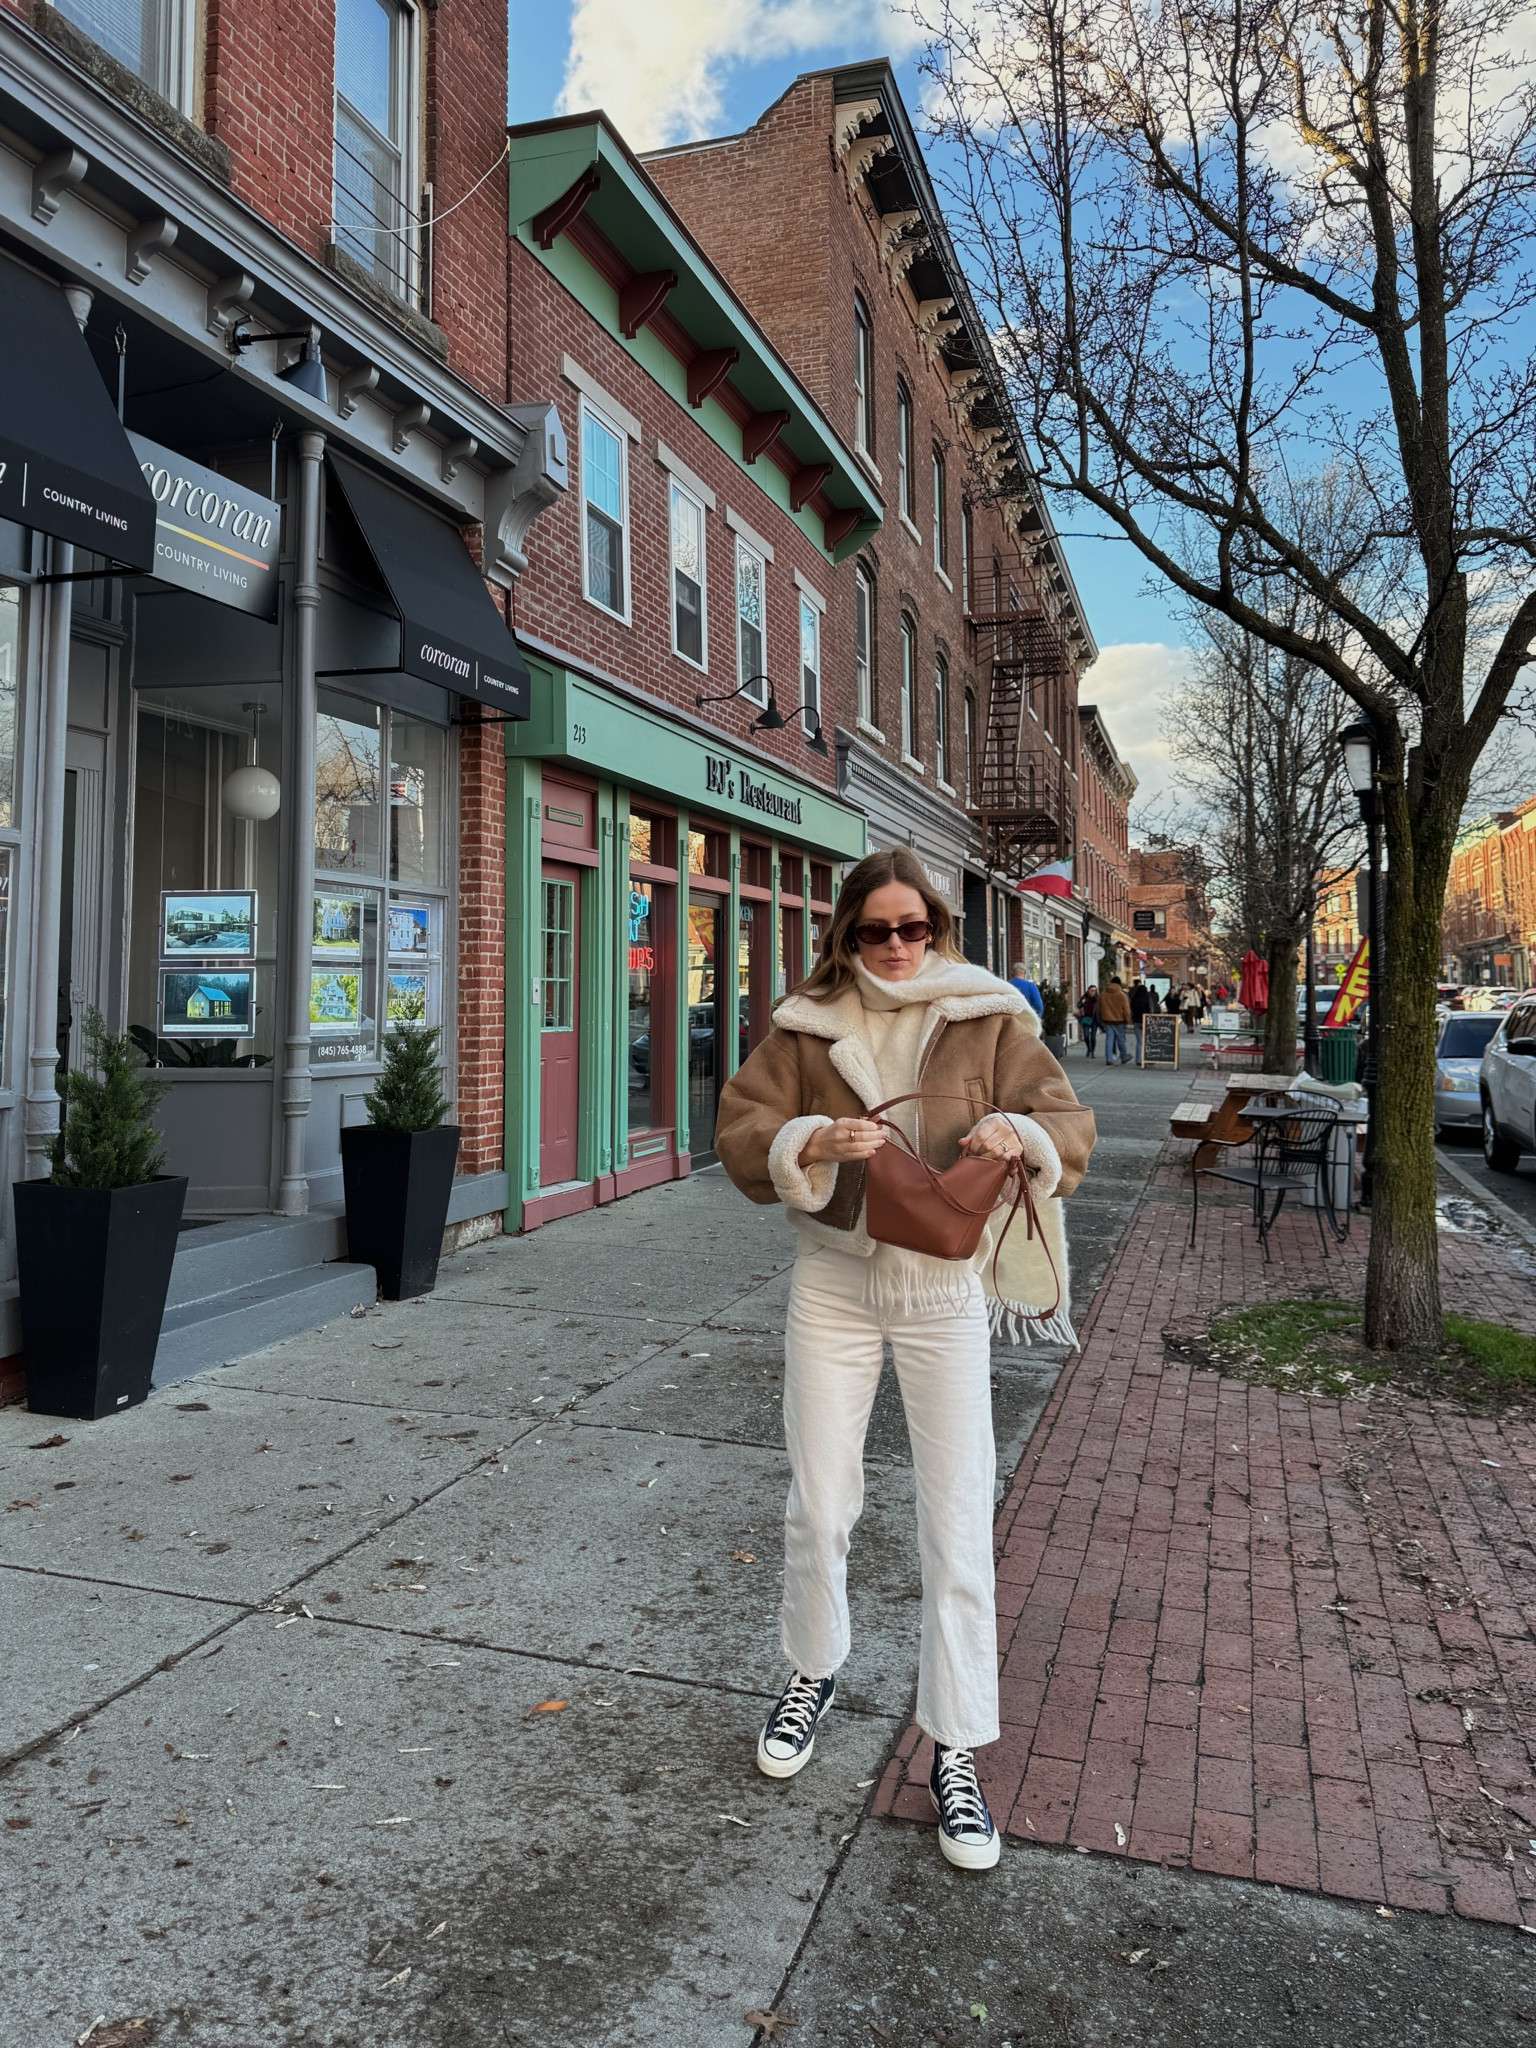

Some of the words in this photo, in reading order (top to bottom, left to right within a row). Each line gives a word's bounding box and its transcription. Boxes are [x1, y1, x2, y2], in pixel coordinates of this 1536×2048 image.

[43, 487, 93, 516] COUNTRY
[95, 509, 128, 531] LIVING
[156, 543, 210, 573] COUNTRY
[213, 565, 248, 588] LIVING
[420, 644, 470, 678] corcoran
[483, 675, 504, 689] COUNTRY
[504, 684, 519, 695] LIVING
[573, 723, 586, 745] 213
[706, 755, 735, 799] BJ's
[740, 770, 802, 825] Restaurant
[317, 1046, 336, 1058] (845)
